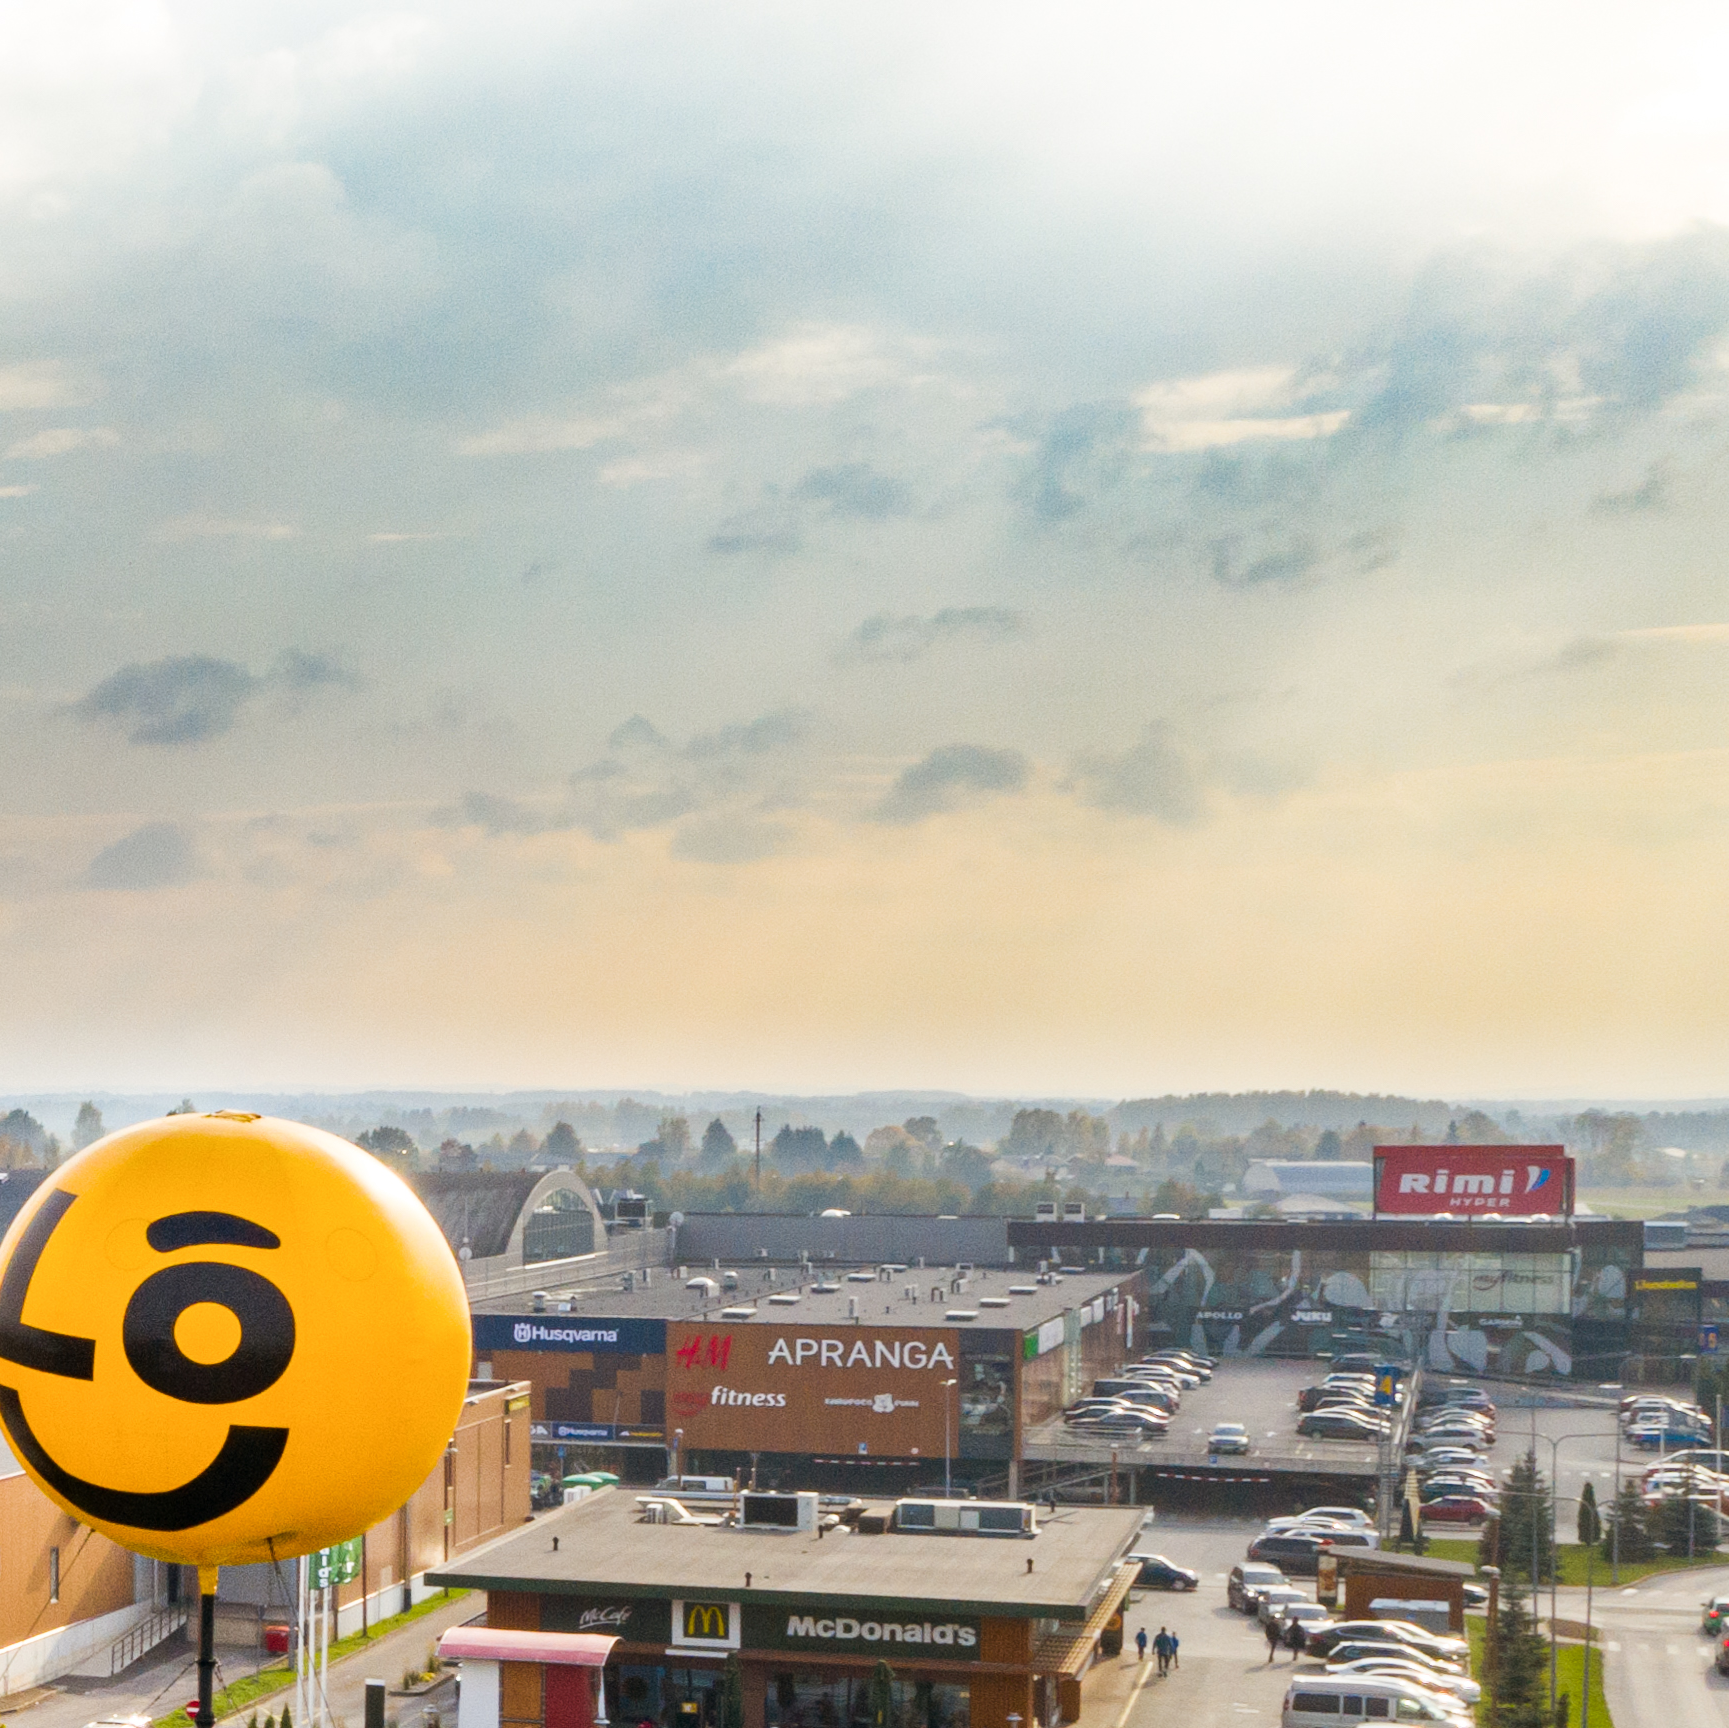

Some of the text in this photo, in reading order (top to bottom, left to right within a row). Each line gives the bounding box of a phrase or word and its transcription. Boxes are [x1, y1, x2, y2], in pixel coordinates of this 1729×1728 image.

[1450, 1198, 1511, 1207] HYPER
[532, 1326, 618, 1343] Husqvarna
[767, 1338, 954, 1370] APRANGA
[1379, 1375, 1392, 1396] 4
[787, 1615, 977, 1648] McDonald's
